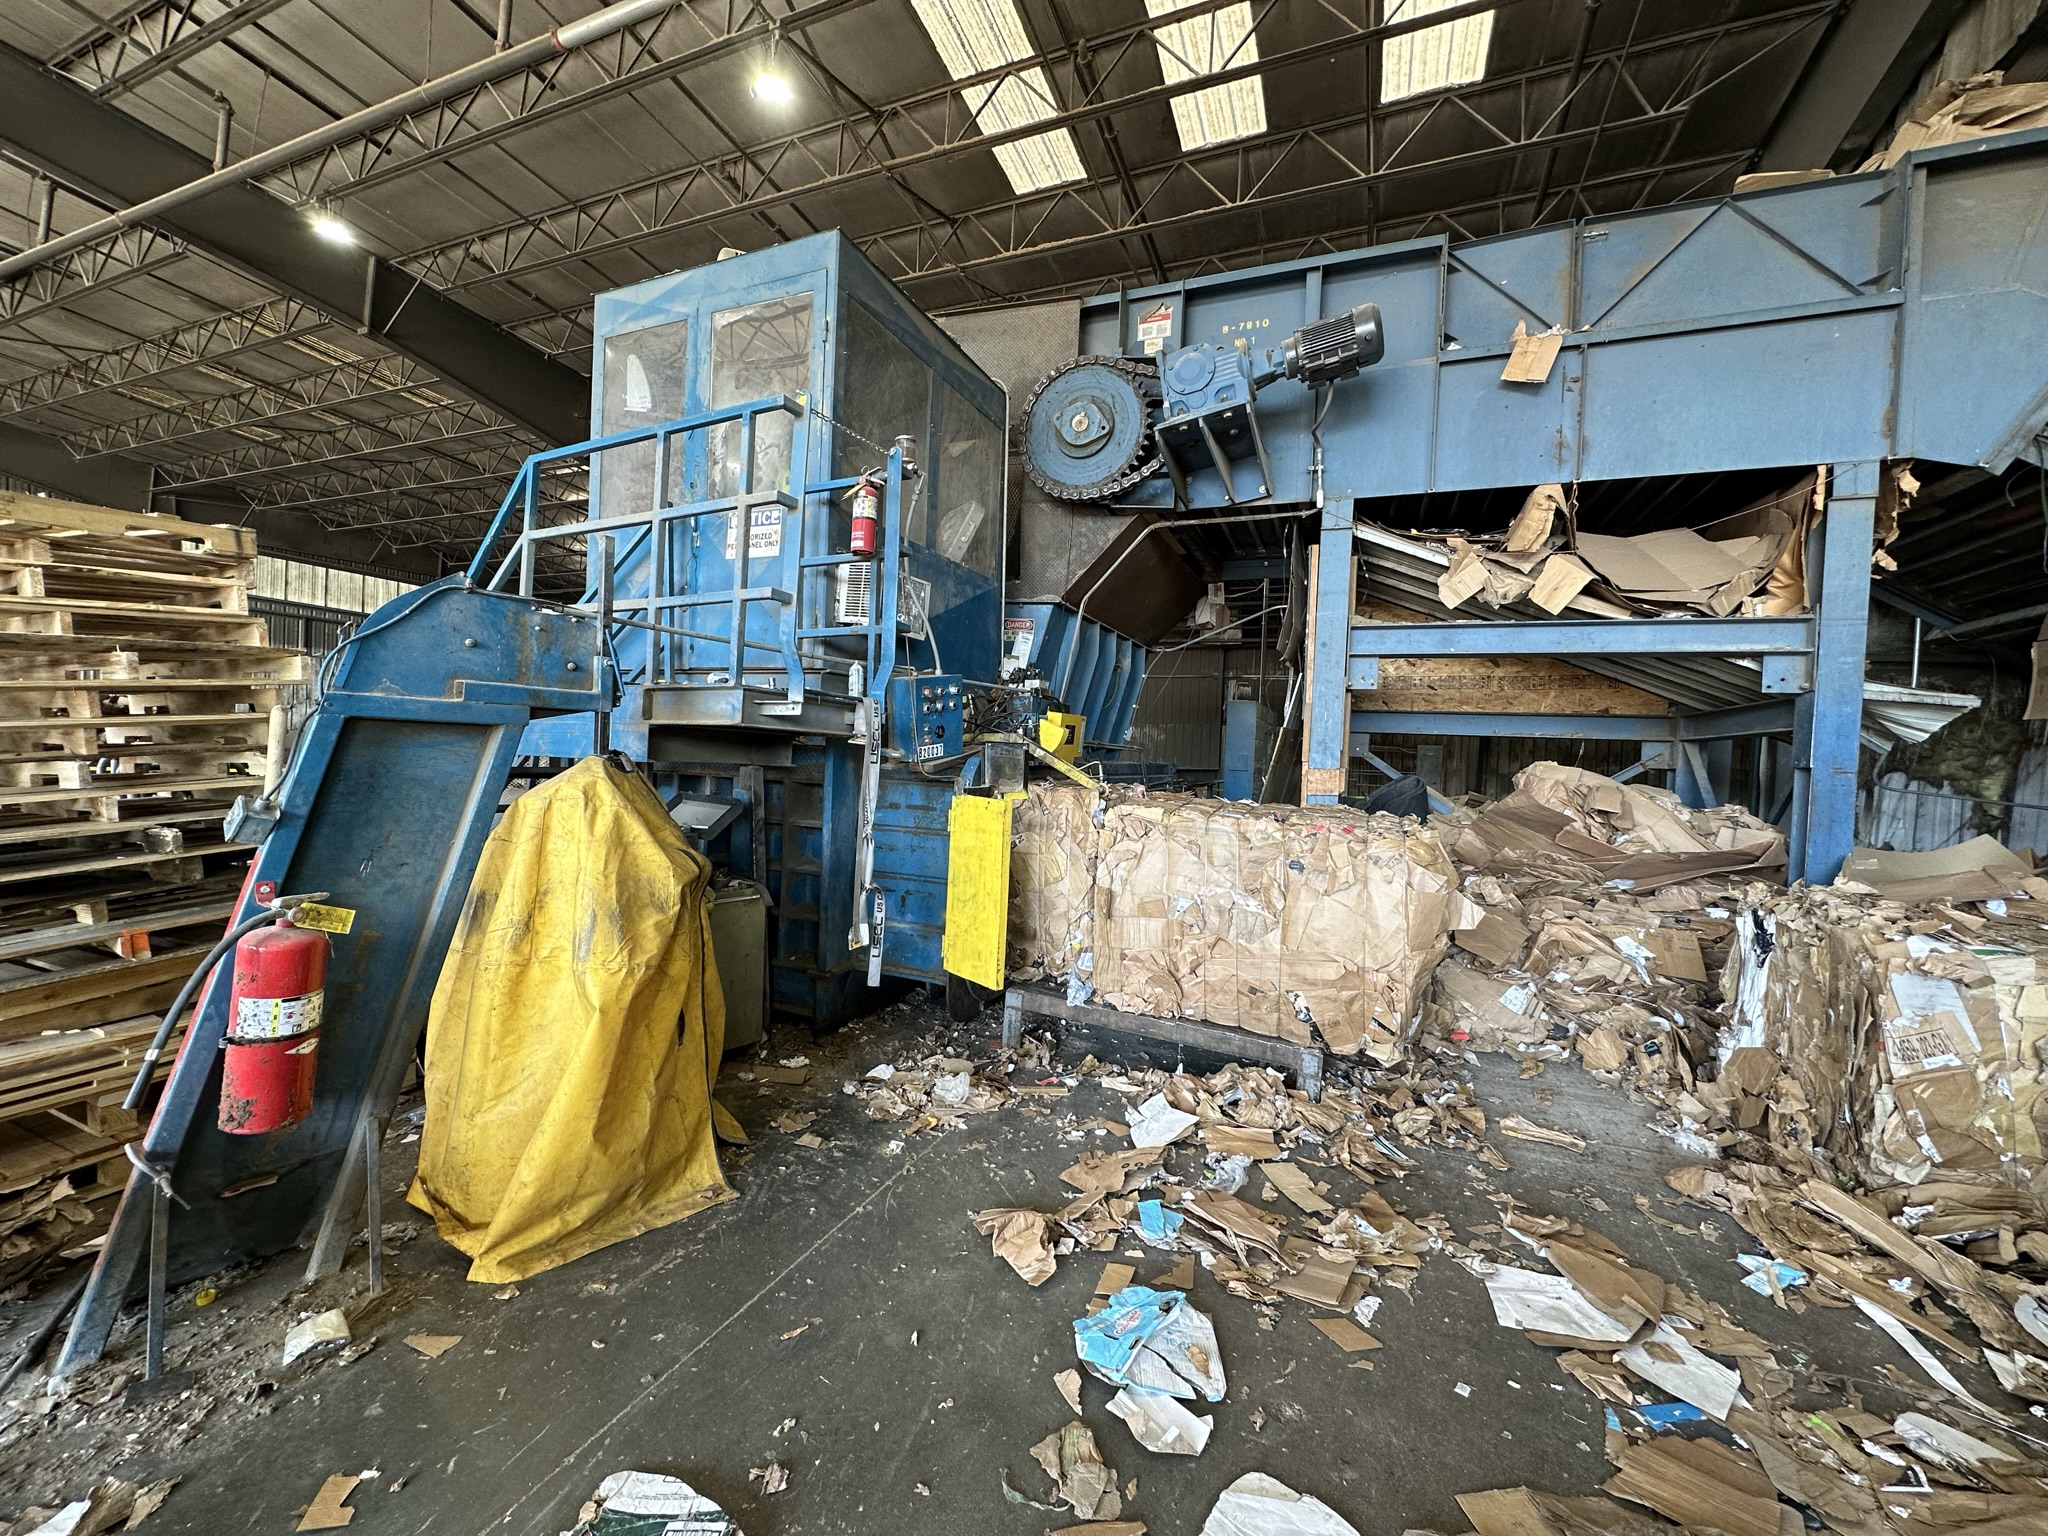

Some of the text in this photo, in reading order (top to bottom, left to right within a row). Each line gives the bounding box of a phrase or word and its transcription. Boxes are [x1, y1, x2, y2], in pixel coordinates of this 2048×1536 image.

[1222, 318, 1270, 334] B-7810
[764, 540, 779, 548] ONLY
[1007, 621, 1031, 629] DANGER
